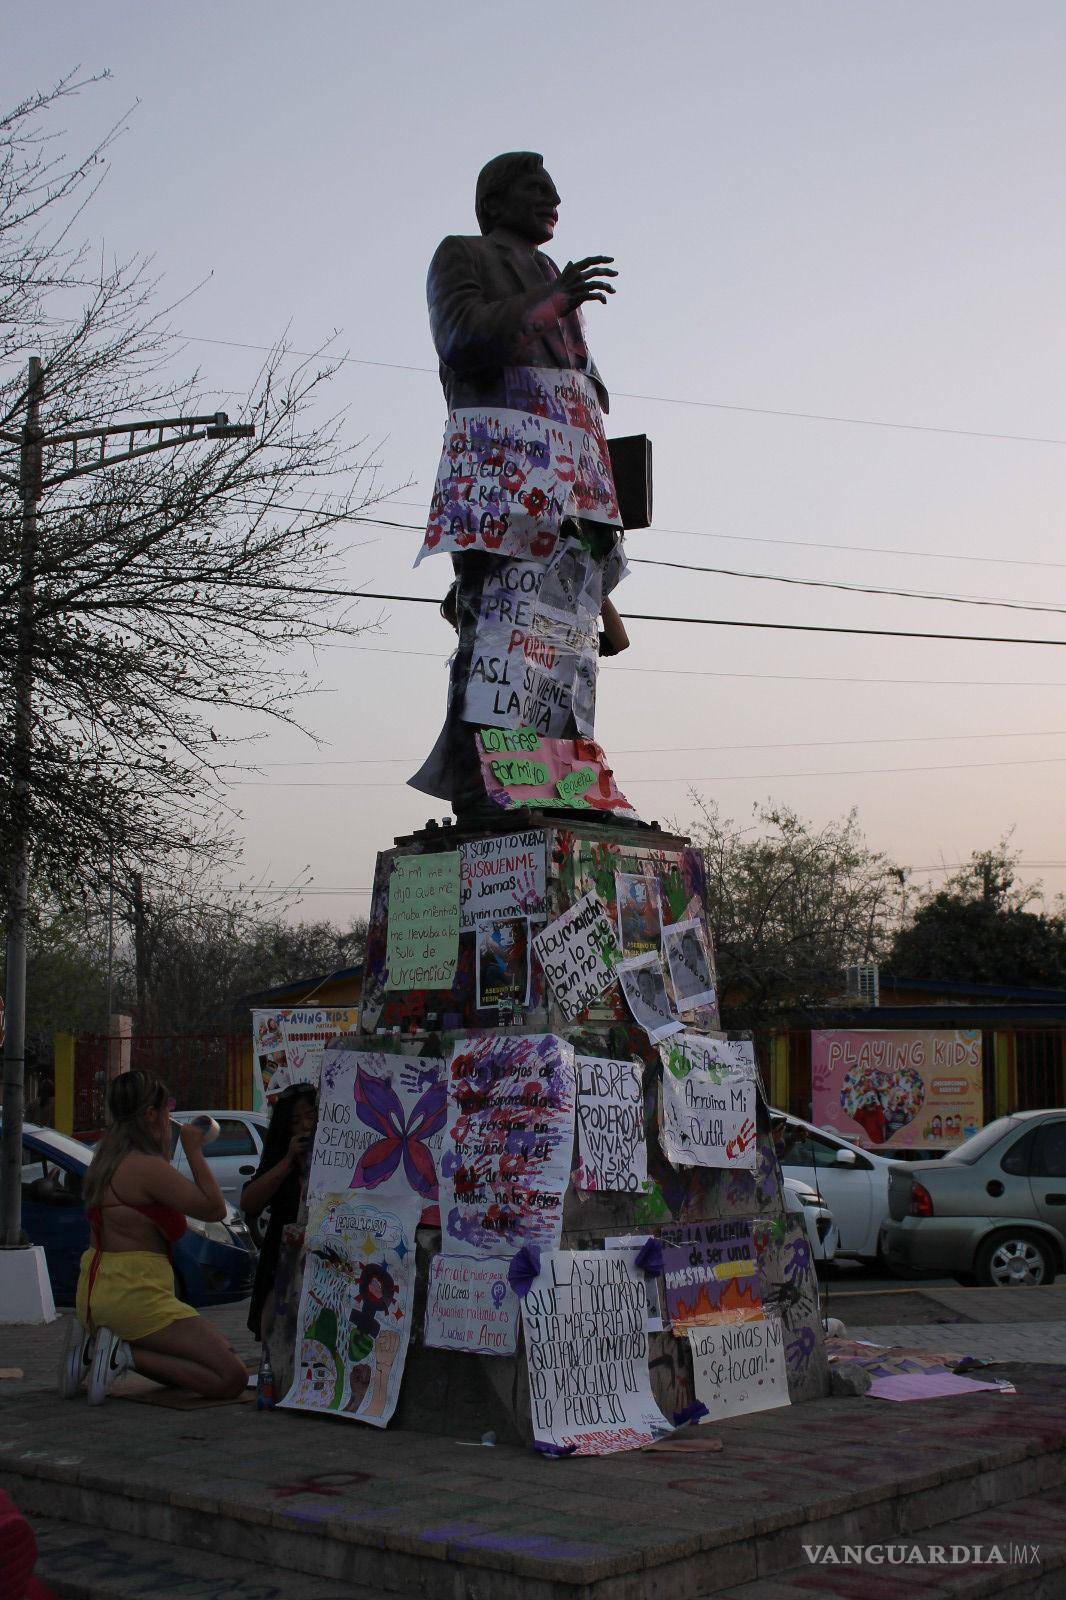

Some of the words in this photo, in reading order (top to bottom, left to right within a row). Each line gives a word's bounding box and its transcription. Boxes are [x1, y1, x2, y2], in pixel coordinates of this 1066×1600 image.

[449, 459, 518, 479] MIEDO
[492, 690, 522, 716] LA
[422, 944, 437, 960] de
[580, 954, 597, 977] no
[277, 1011, 323, 1026] PLAYING
[828, 1040, 925, 1070] PLAYING
[932, 1038, 982, 1068] KIDS
[576, 1061, 643, 1105] LIBRES
[730, 1089, 746, 1112] Mi
[322, 1103, 351, 1124] NOS
[313, 1150, 354, 1170] MIEDO
[594, 1152, 604, 1172] Y
[585, 1164, 639, 1192] MIEDO
[551, 1259, 631, 1287] LASTIMA
[664, 1265, 716, 1289] MAESTRA
[525, 1286, 563, 1317] QUE
[571, 1286, 587, 1315] EL
[693, 1330, 715, 1357] Las
[535, 1399, 554, 1430] LO
[564, 1393, 627, 1427] PENDEJO
